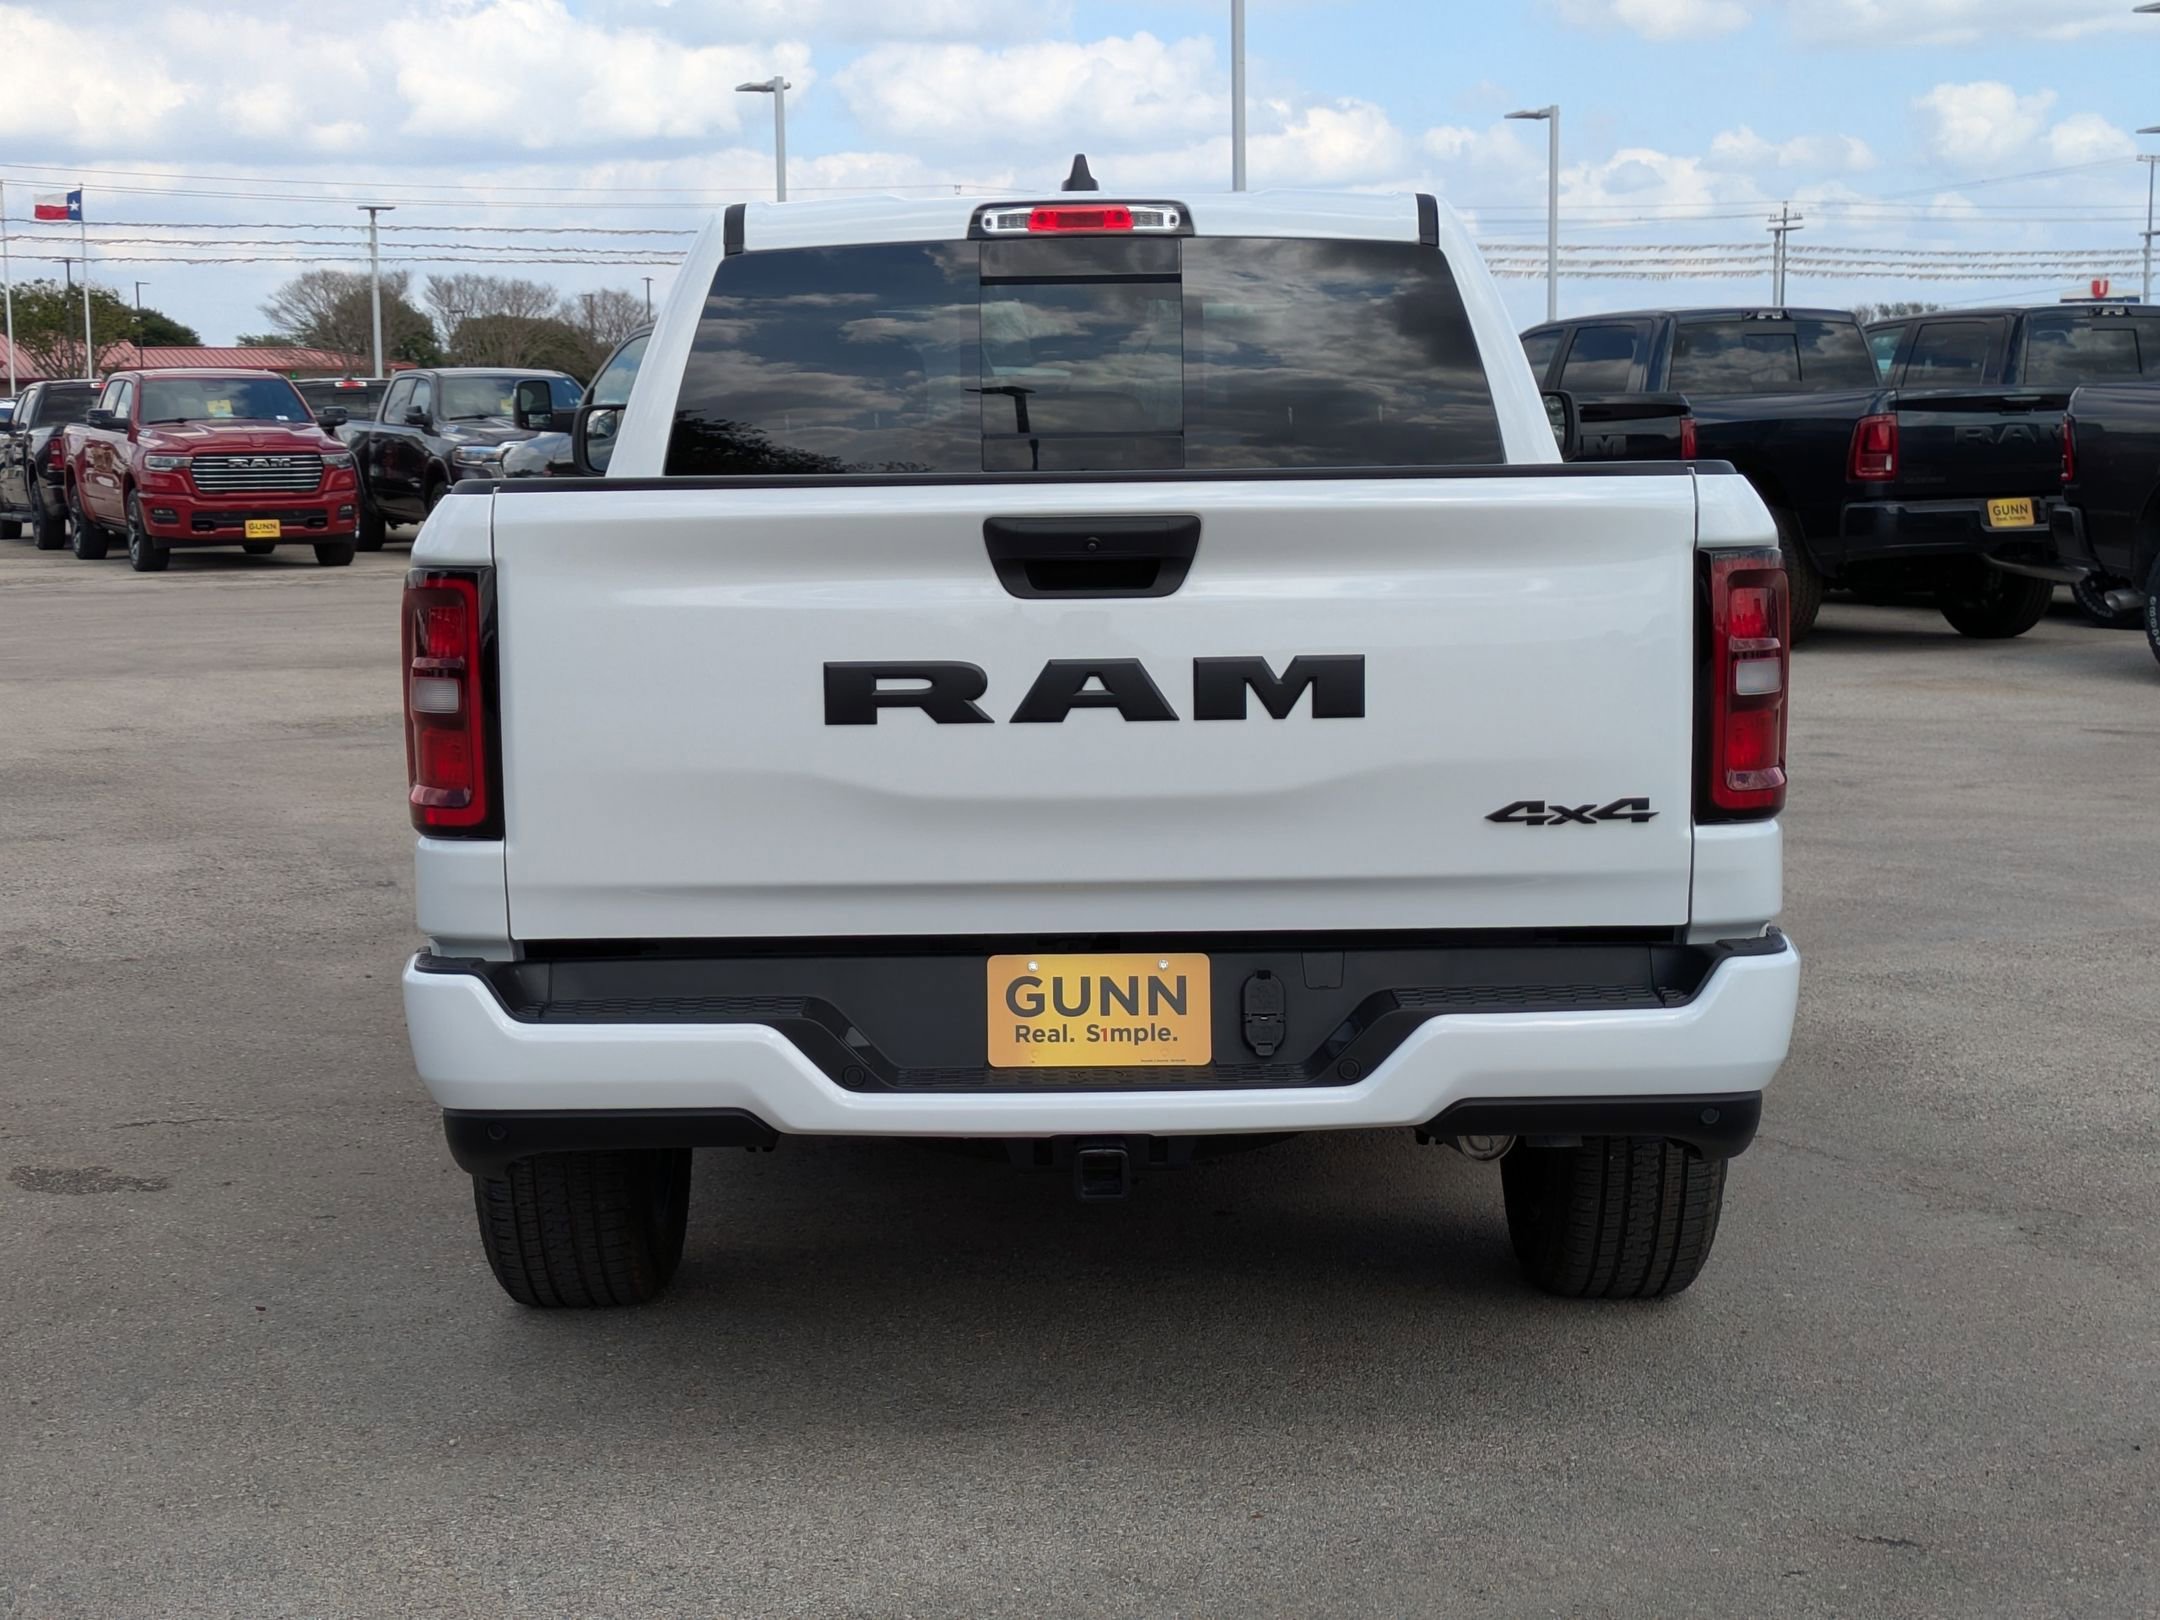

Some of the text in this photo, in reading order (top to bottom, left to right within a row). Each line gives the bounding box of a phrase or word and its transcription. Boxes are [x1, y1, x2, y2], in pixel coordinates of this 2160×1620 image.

[1992, 504, 2029, 516] GUNN
[248, 522, 277, 531] GUNN
[823, 654, 1365, 725] RAM
[1484, 797, 1660, 826] 4x4
[1005, 975, 1187, 1018] GUNN
[1015, 1024, 1075, 1043] Real.
